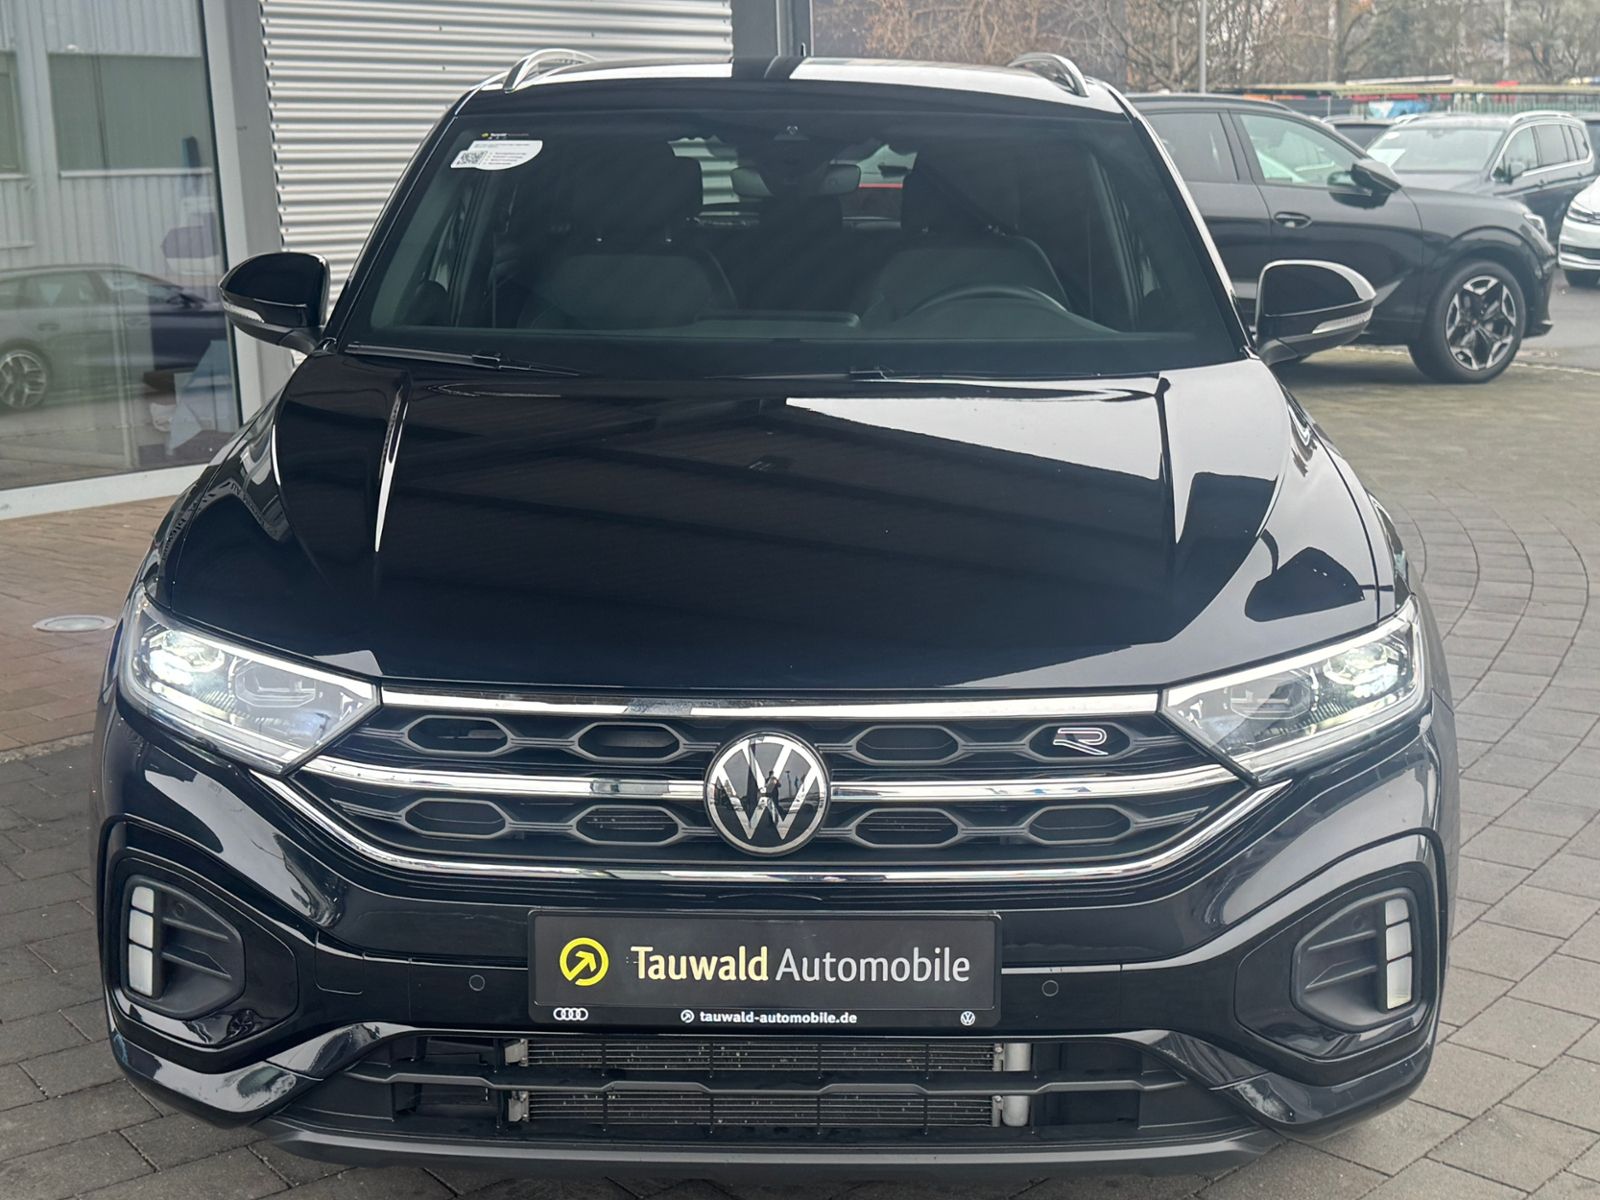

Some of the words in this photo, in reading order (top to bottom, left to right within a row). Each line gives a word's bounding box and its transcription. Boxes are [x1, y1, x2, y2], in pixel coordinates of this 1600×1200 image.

[630, 945, 769, 981] Tauwald
[775, 946, 970, 982] Automobile
[699, 1011, 858, 1024] tauwald-automobile.de
